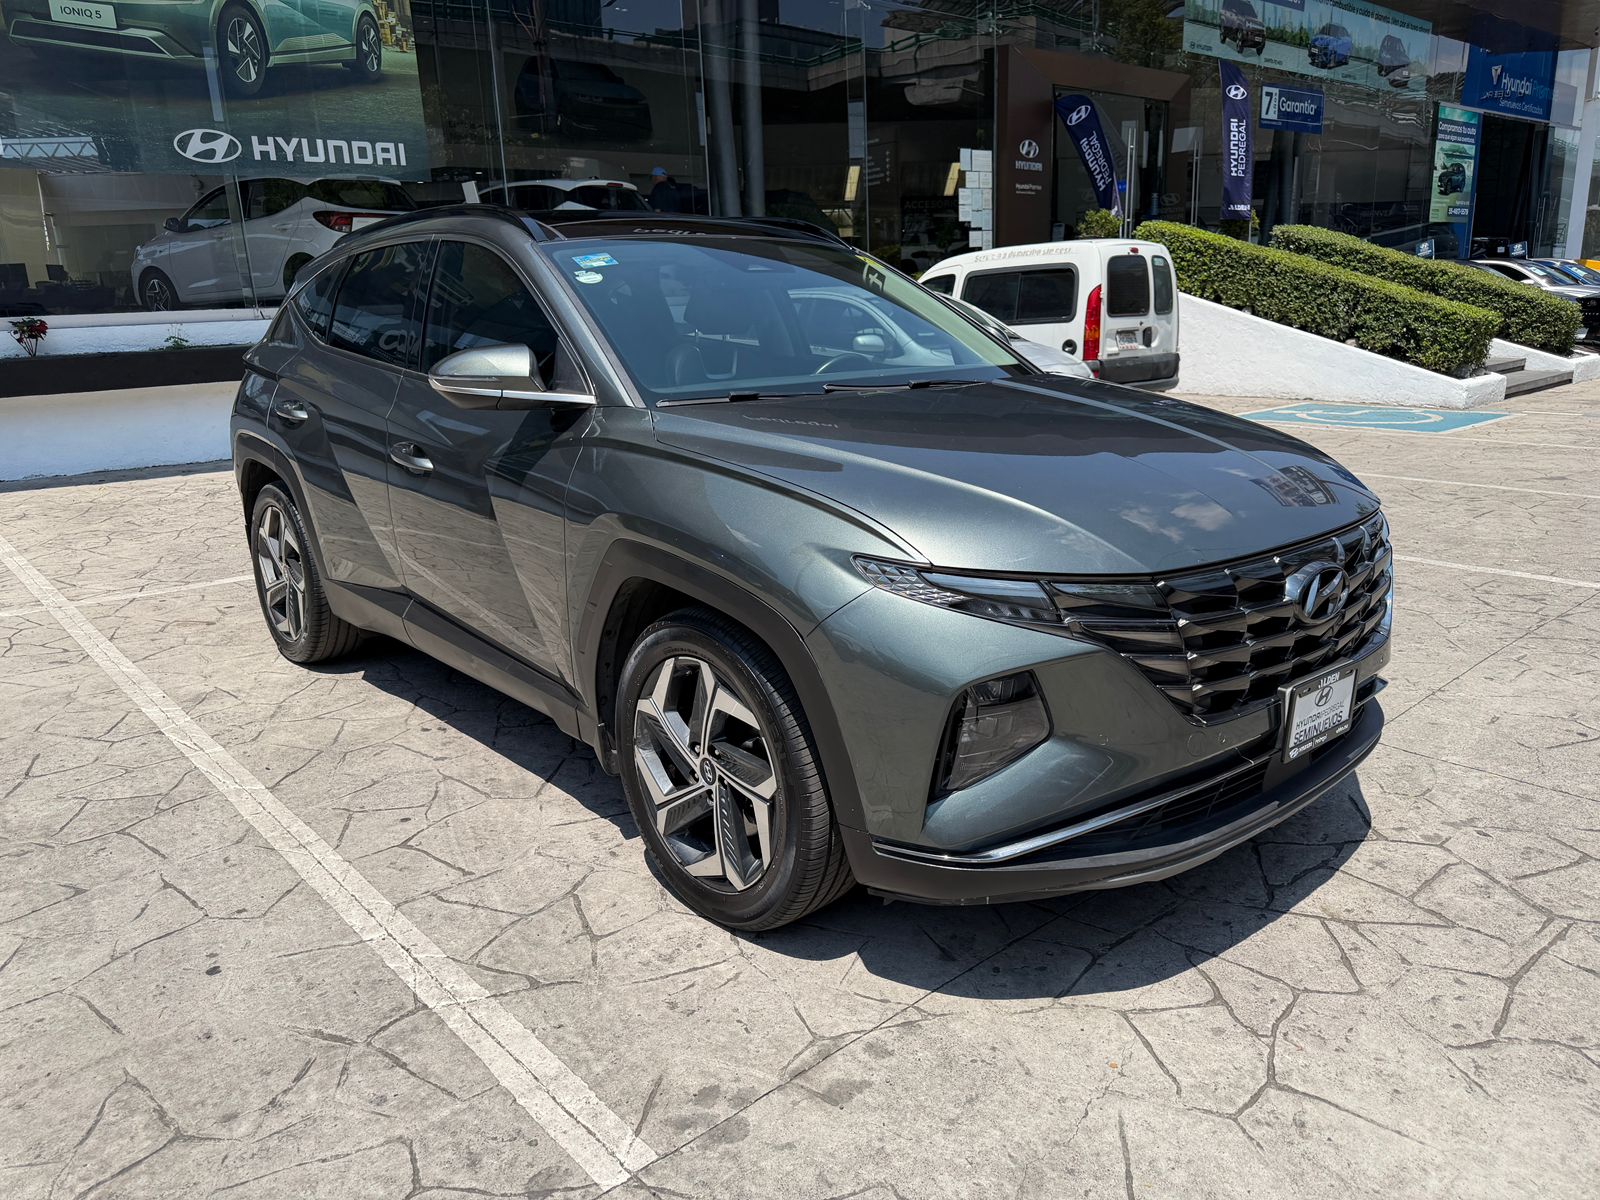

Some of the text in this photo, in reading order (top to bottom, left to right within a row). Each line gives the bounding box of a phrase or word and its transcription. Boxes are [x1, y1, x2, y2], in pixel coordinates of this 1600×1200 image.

[60, 6, 102, 19] IONIQ 5
[1264, 91, 1274, 116] 7
[250, 135, 407, 166] HYUNDAI
[1080, 137, 1106, 192] HYUNDAI
[1088, 130, 1112, 184] PEDREGAL
[1230, 118, 1239, 177] HYUNDAI
[1237, 119, 1247, 177] PEDREGAL
[1015, 160, 1043, 171] HYUNDAI
[1293, 711, 1343, 745] SEMINUEVOS
